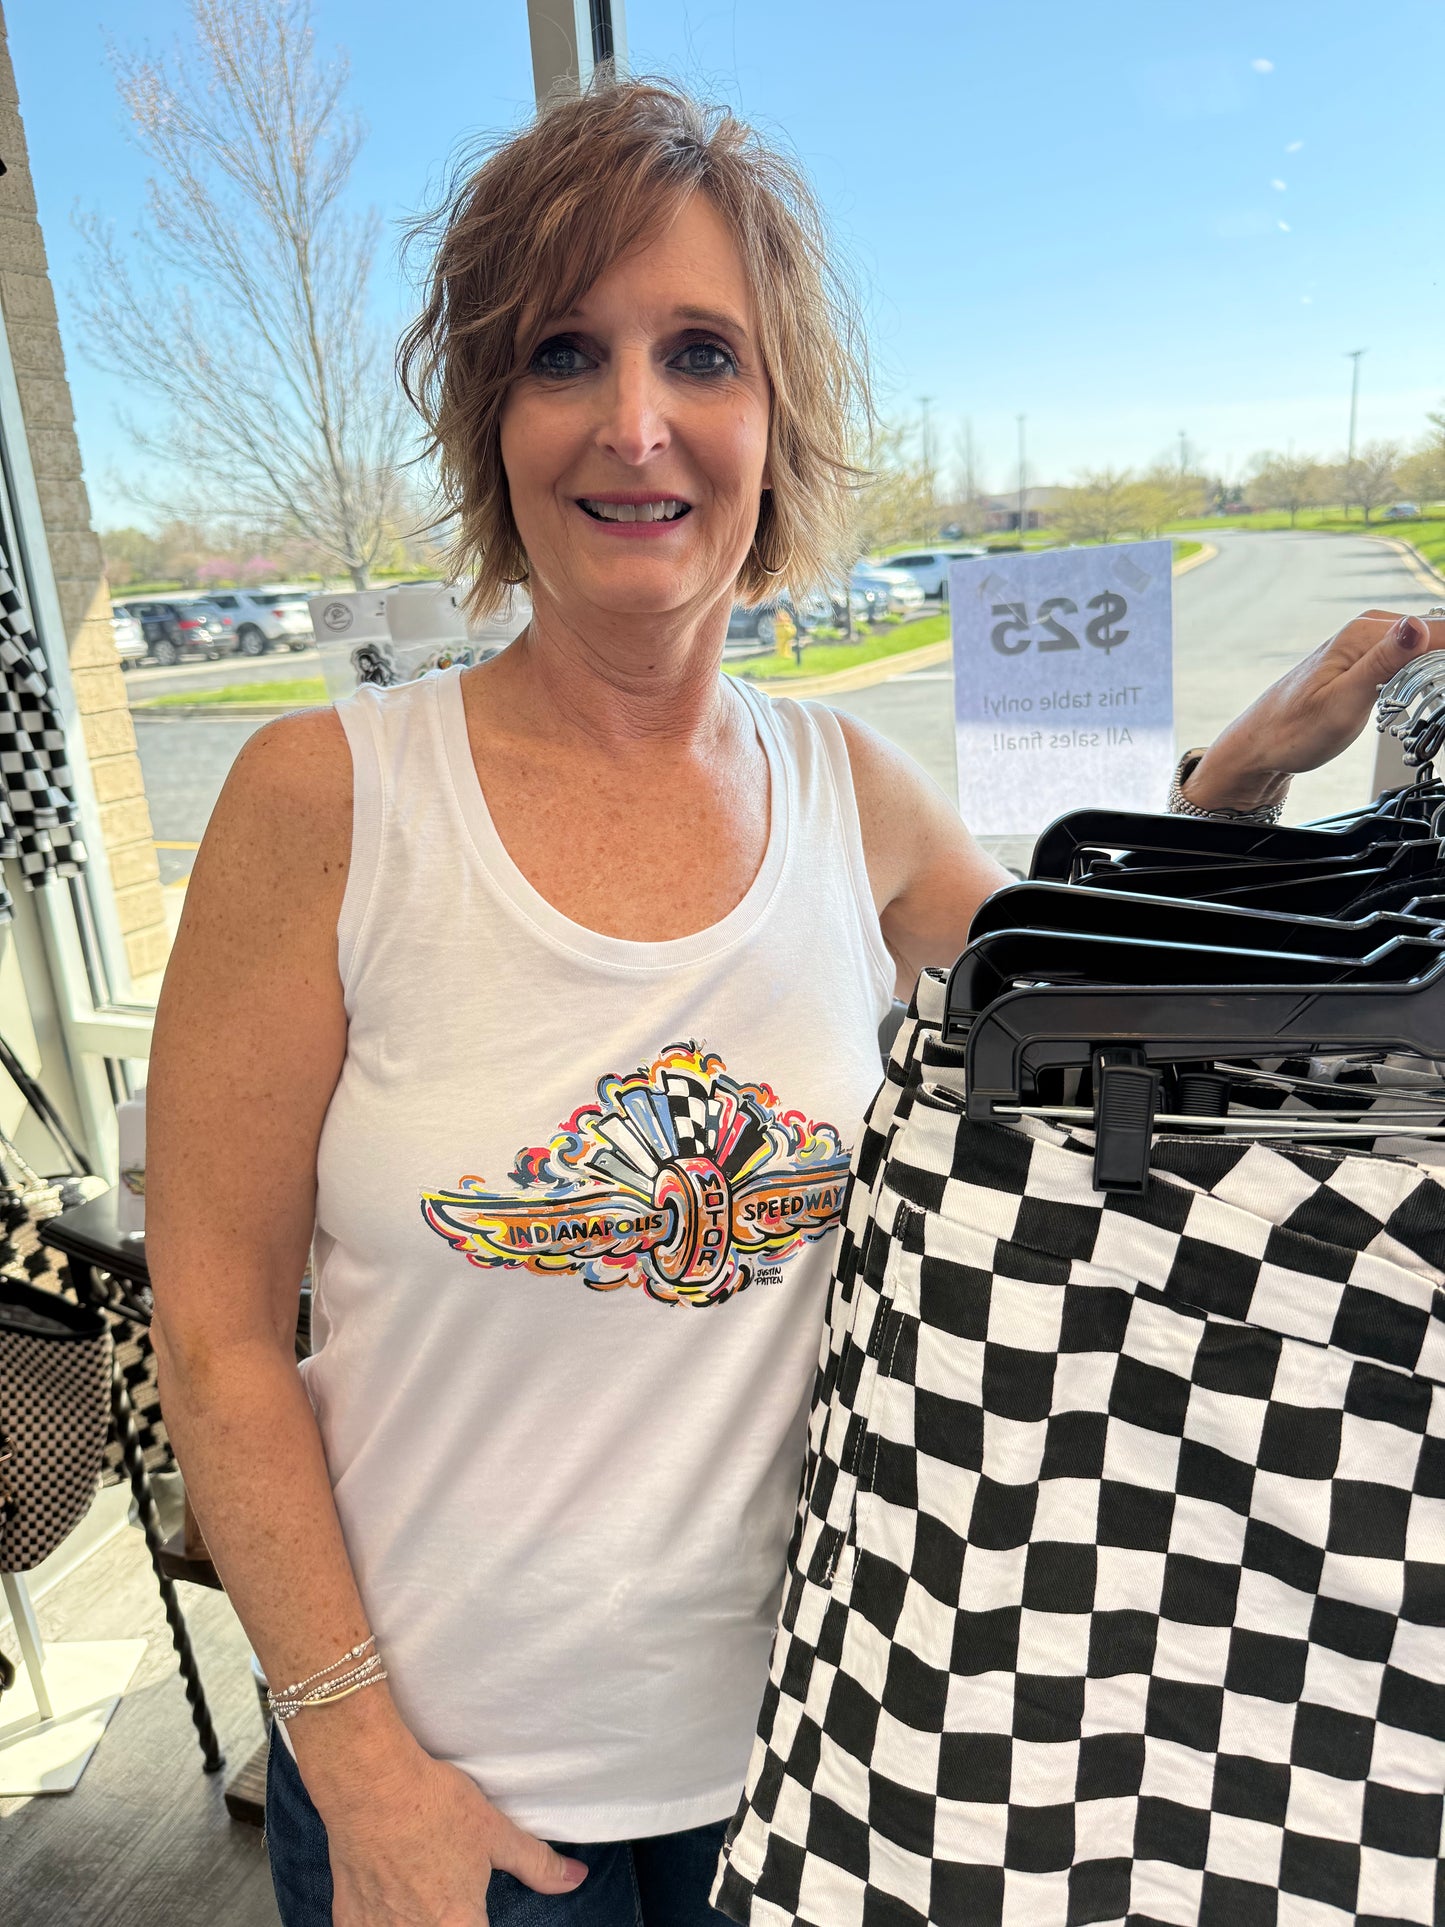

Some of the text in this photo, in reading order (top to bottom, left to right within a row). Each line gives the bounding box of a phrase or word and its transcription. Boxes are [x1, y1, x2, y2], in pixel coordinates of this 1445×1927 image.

[743, 1186, 845, 1221] SPEEDWAY
[508, 1214, 663, 1246] INDIANAPOLIS
[698, 1174, 725, 1267] MOTOR
[754, 1275, 783, 1286] PATTEN
[757, 1266, 781, 1277] JUSTIN
